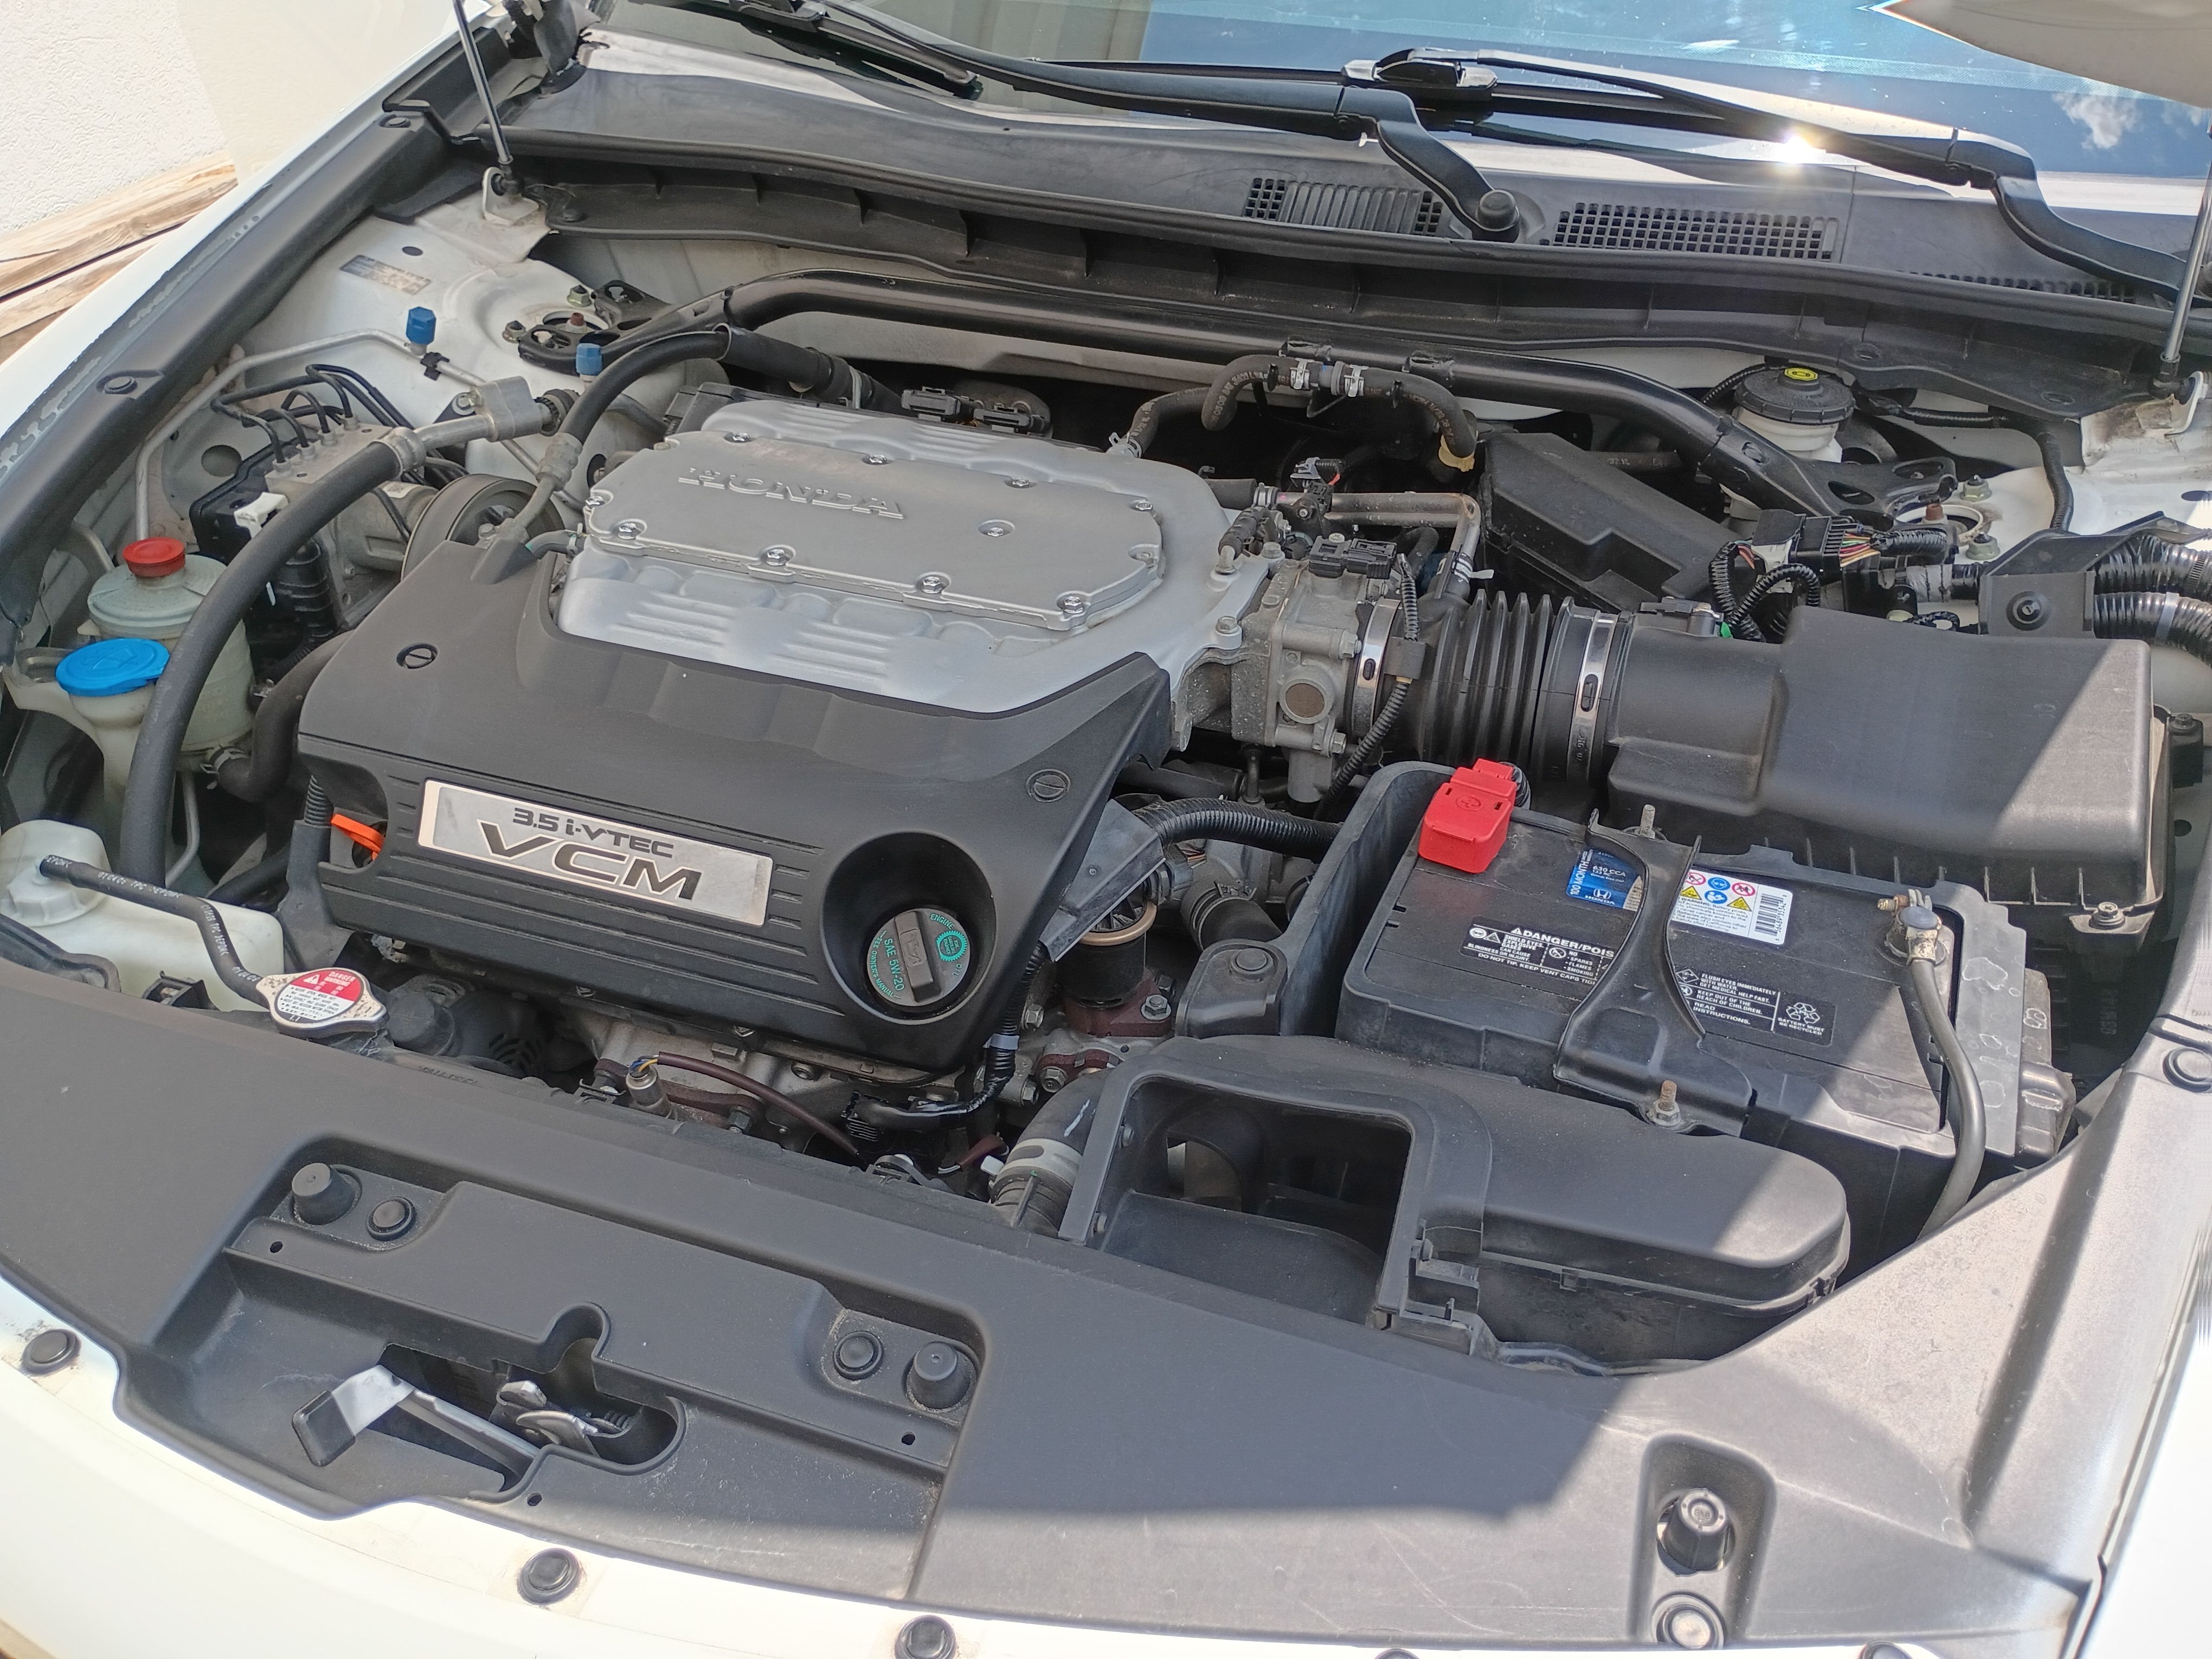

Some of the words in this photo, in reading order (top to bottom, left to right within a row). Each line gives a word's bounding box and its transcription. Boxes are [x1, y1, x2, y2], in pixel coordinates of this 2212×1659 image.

[678, 467, 904, 519] HONDA
[512, 807, 560, 831] 3.5
[566, 818, 673, 858] i-VTEC
[477, 819, 702, 901] VCM
[1573, 861, 1590, 885] MONTH
[1570, 885, 1581, 895] 100
[1585, 895, 1616, 905] HONDA
[1681, 897, 1712, 907] WARNING:
[930, 913, 955, 930] ENGINE
[873, 937, 882, 949] SEE
[1503, 938, 1536, 950] EXPLOSIVE
[1504, 935, 1525, 943] SHIELD
[1523, 930, 1615, 957] DANGER/POIS
[884, 938, 896, 957] SAE
[1467, 943, 1499, 954] BLINDNESS
[1501, 943, 1521, 951] GASES
[1512, 949, 1531, 957] CAUSE
[889, 959, 904, 991] 5W-20
[952, 963, 963, 976] OIL
[1540, 968, 1558, 976] VENT
[1560, 973, 1580, 981] CAPS
[329, 971, 356, 982] DANGER
[876, 978, 895, 998] MANUAL
[1701, 973, 1720, 982] FLUSH
[1737, 982, 1776, 995] IMMEDIATELY
[1712, 985, 1737, 995] MEDICAL
[1696, 994, 1718, 1003] REACH
[1694, 1002, 1715, 1011] READ
[1693, 1007, 1751, 1025] INSTRUCTIONS.
[1778, 1017, 1806, 1027] BATTERY
[1789, 1024, 1822, 1036] RECYCLED
